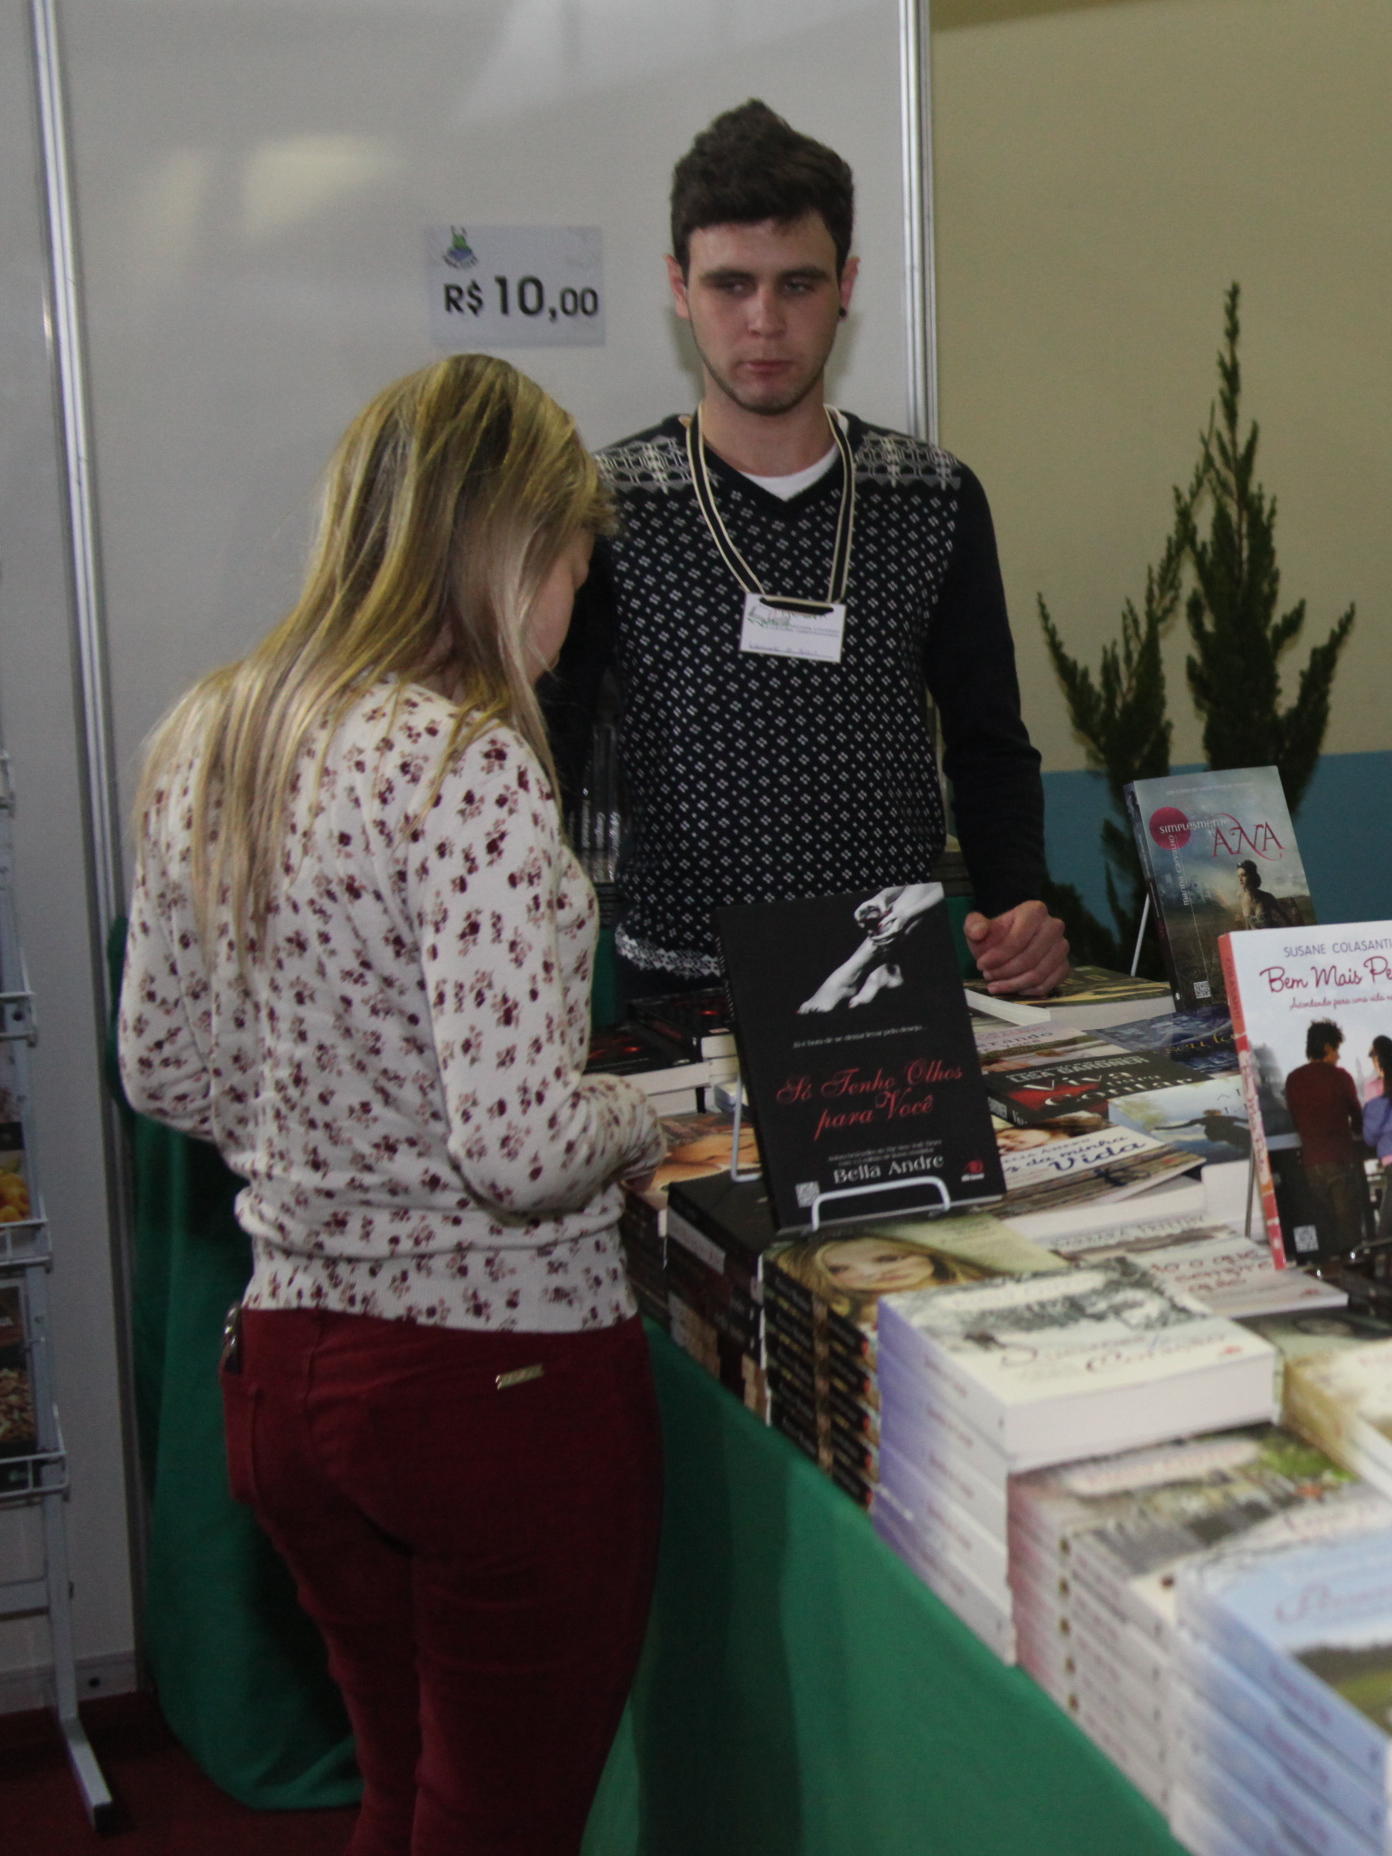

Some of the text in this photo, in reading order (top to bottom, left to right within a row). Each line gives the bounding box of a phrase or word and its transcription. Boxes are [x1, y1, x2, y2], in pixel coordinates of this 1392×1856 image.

[444, 275, 598, 322] R$ 10,00
[1210, 812, 1285, 861] ANA
[1284, 938, 1392, 958] SUSANE COLASANTI
[1259, 966, 1308, 993] Bem
[1310, 965, 1362, 988] Mais
[776, 1058, 964, 1104] Só Tenho Olhos
[1006, 1067, 1056, 1083] LISA
[814, 1087, 935, 1141] para Você
[833, 1155, 944, 1184] Bella Andre
[1048, 1142, 1147, 1172] Vida
